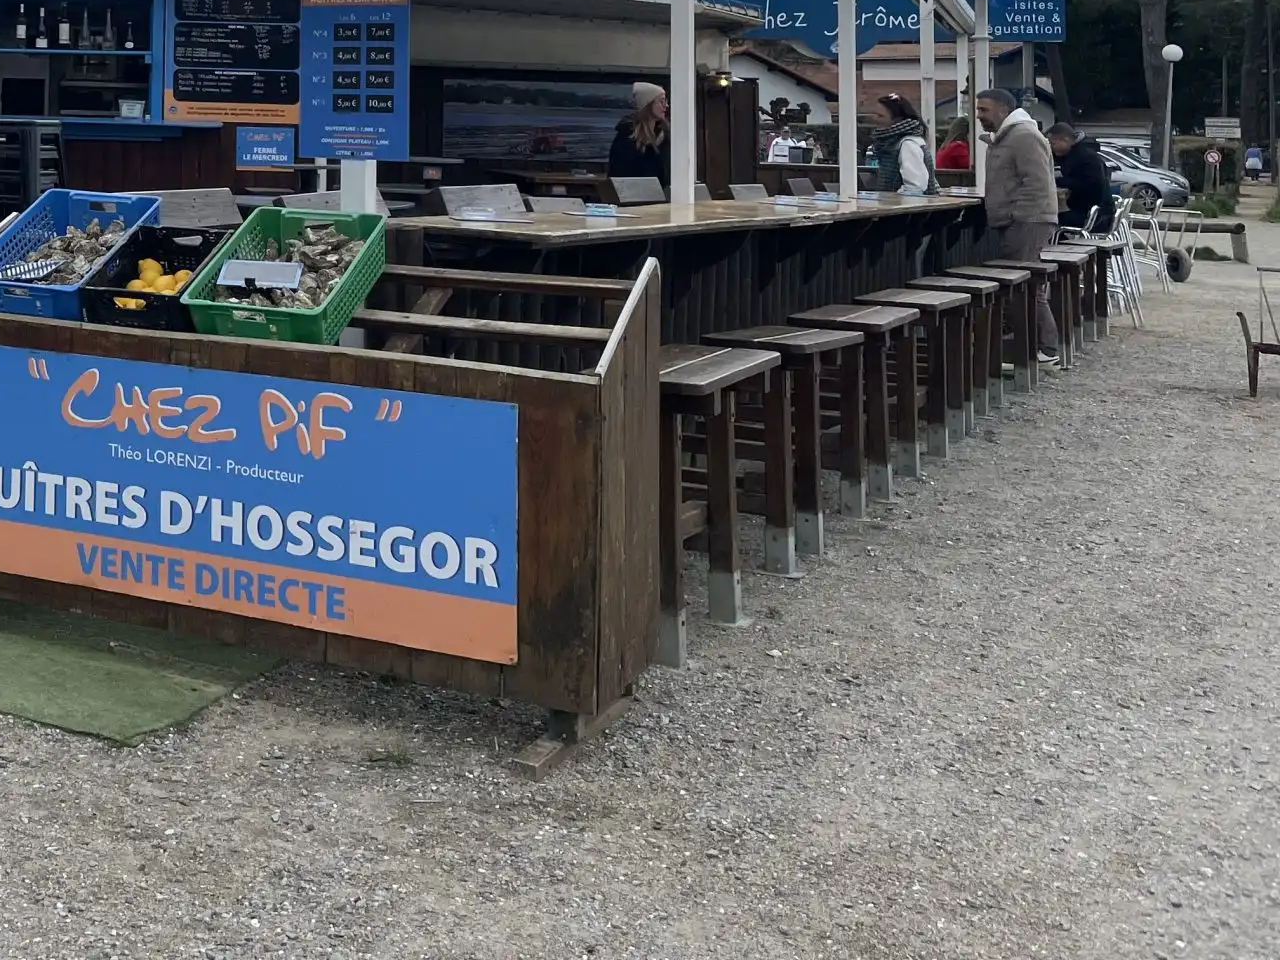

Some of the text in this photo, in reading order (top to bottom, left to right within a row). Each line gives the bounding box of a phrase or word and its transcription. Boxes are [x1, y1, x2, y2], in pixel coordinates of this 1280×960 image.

[382, 13, 391, 21] 12
[1005, 13, 1061, 23] Vente &
[1007, 0, 1060, 11] isites,
[61, 367, 237, 444] CHEZ
[108, 443, 142, 461] Théo
[146, 448, 212, 472] LORENZI
[226, 459, 304, 485] Producteur
[160, 490, 500, 588] D'HOSSEGOR
[77, 543, 346, 620] VENTE DIRECTE
